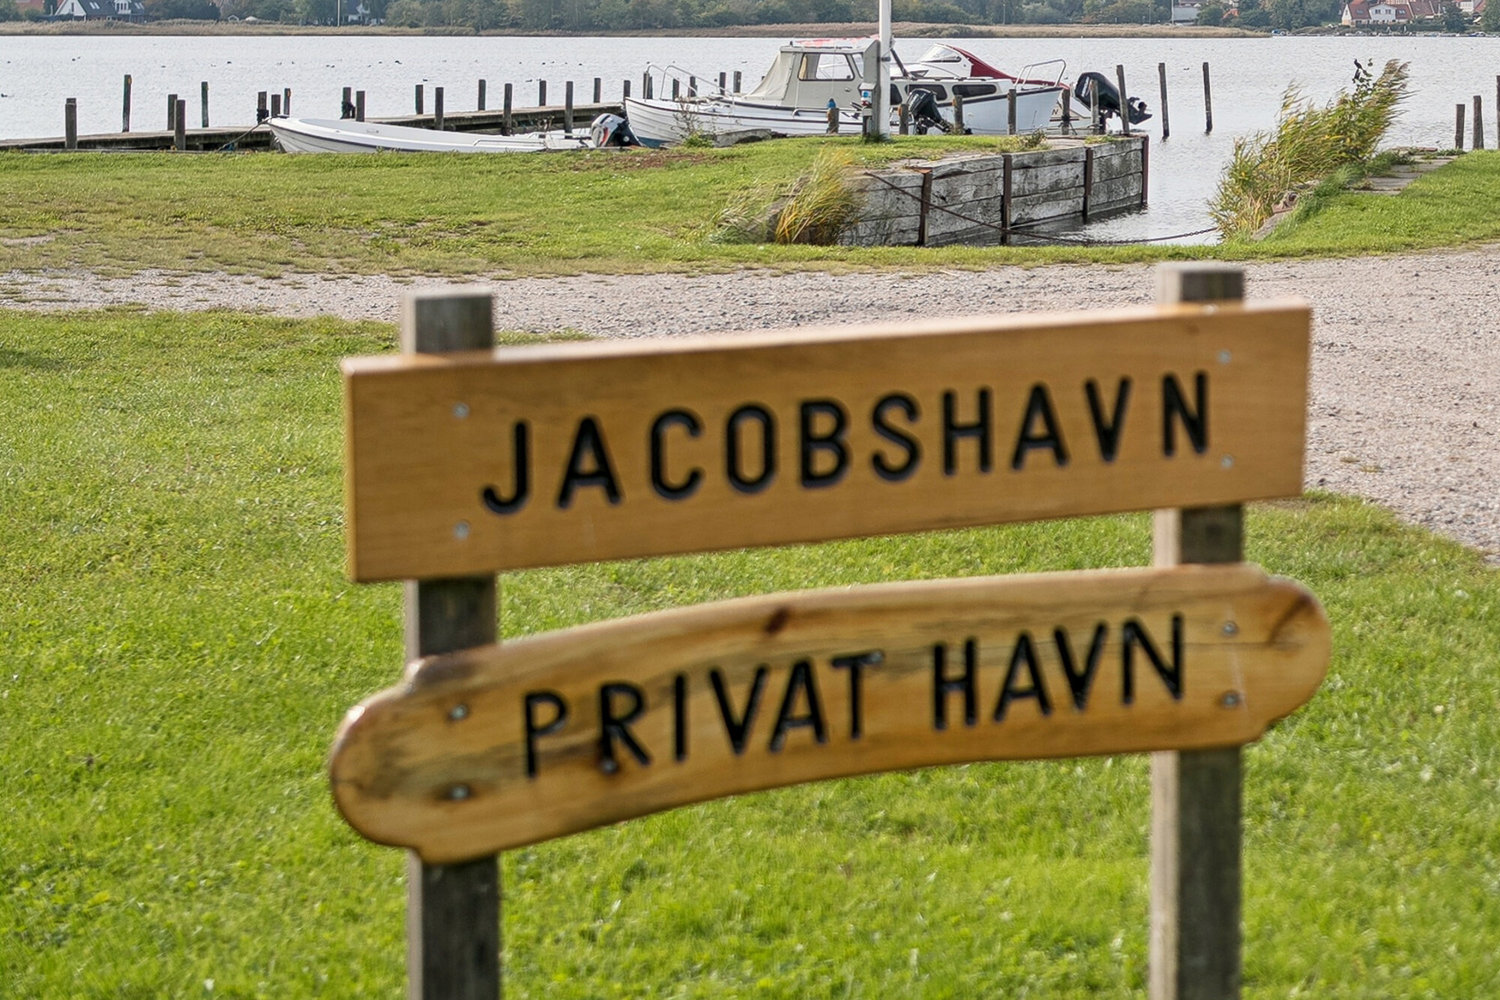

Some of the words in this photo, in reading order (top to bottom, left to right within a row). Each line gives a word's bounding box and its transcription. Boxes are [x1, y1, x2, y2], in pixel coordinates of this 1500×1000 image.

[478, 369, 1210, 517] JACOBSHAVN
[521, 649, 886, 782] PRIVAT
[929, 612, 1185, 734] HAVN
